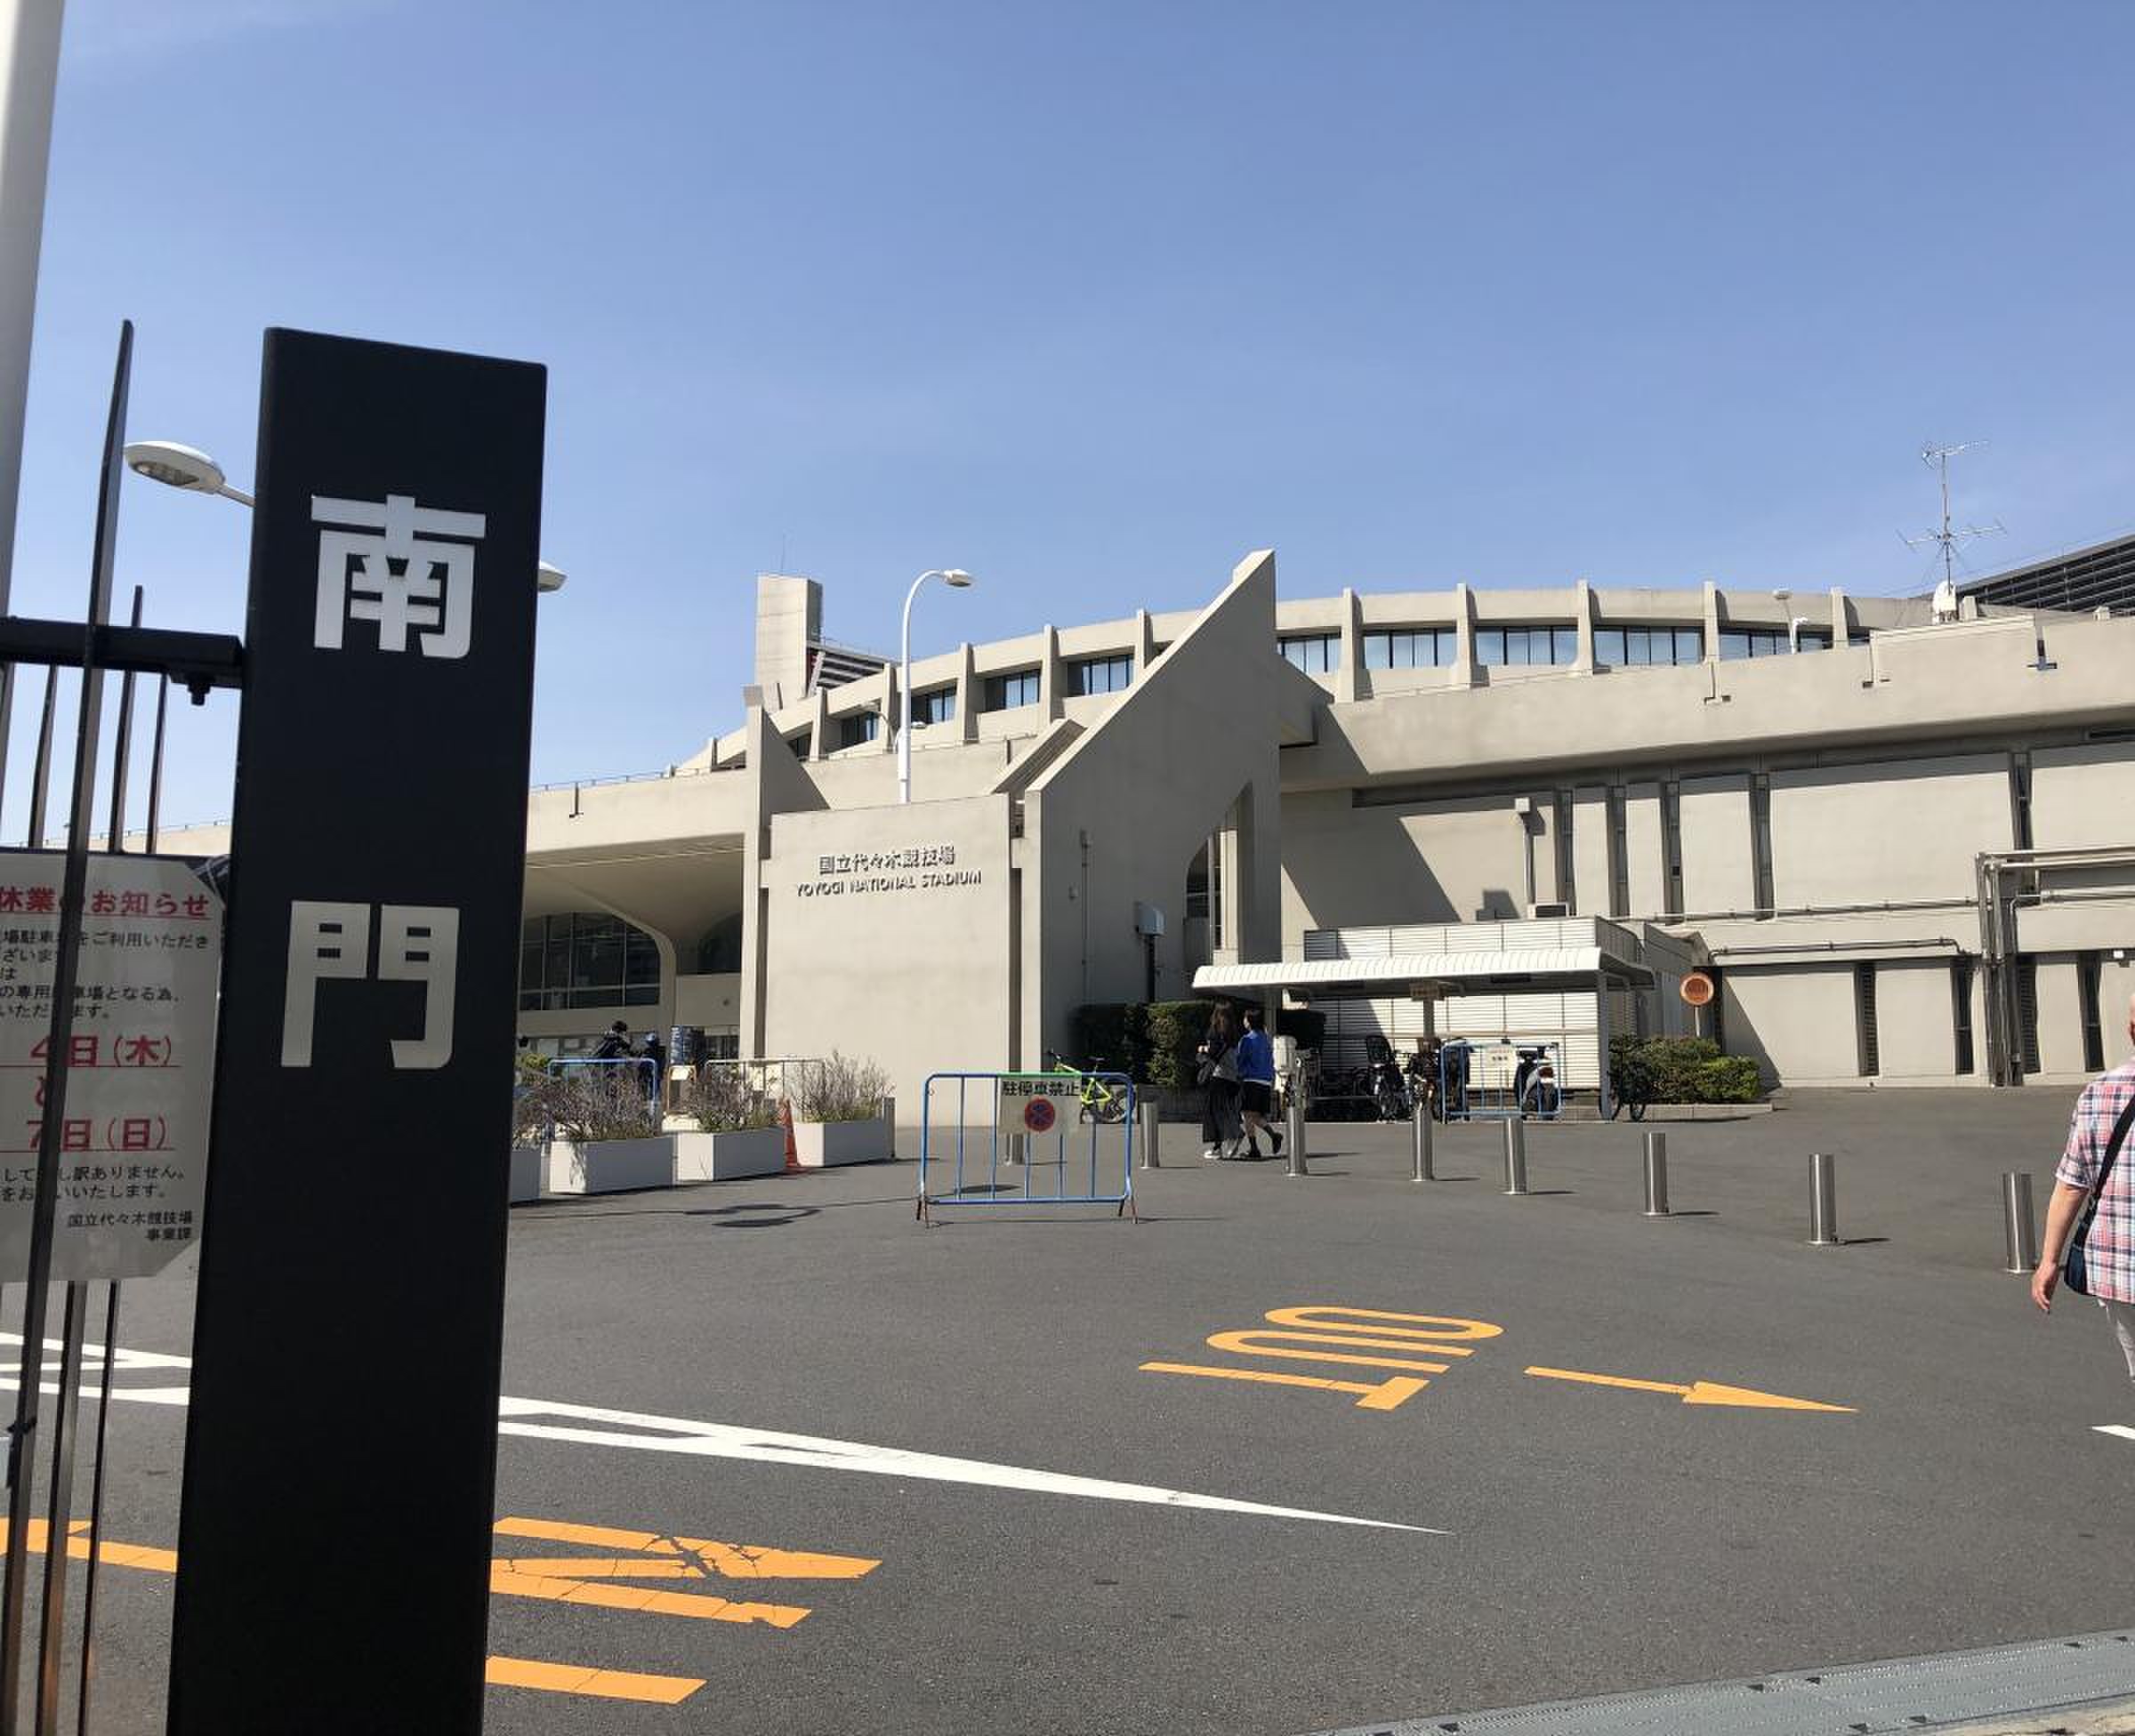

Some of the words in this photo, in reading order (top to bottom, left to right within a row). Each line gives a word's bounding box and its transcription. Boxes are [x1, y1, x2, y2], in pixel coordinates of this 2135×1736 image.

[281, 494, 487, 1069] 南門
[818, 846, 955, 875] 国立代々木競技場
[797, 881, 845, 896] YOYOGI
[850, 875, 916, 893] NATIONAL
[922, 870, 982, 888] STADIUM
[0, 886, 210, 917] 休業お知らせ
[1001, 1081, 1081, 1097] 駐停車禁止
